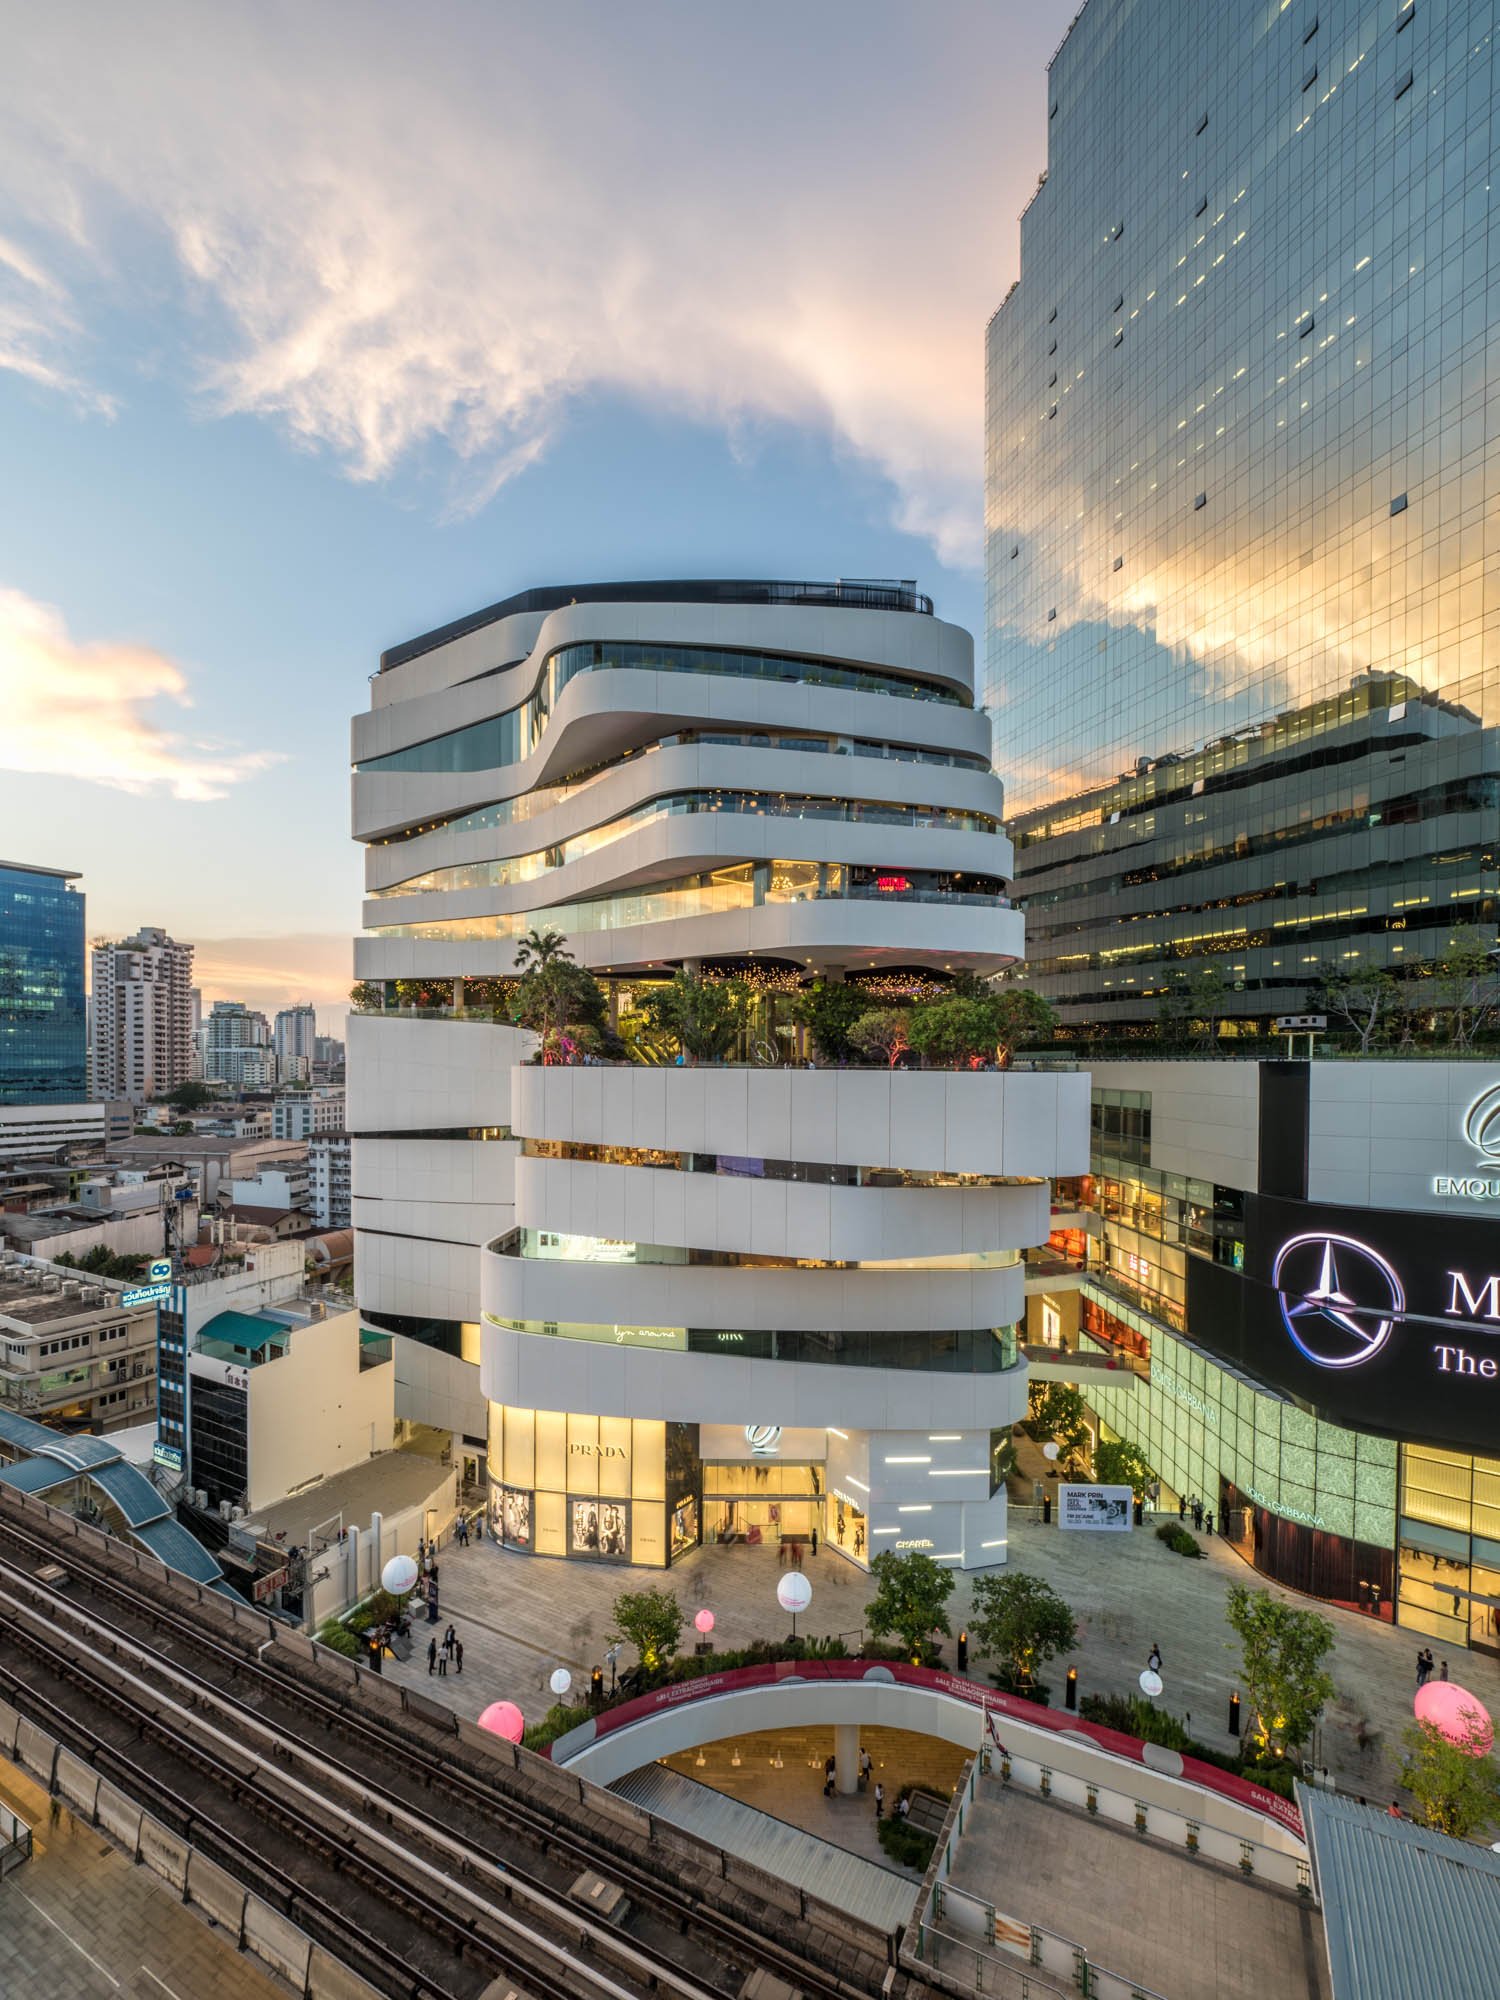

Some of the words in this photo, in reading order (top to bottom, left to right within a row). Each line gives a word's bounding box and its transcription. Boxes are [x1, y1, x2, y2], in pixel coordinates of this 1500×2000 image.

[613, 1323, 635, 1342] lyn
[638, 1328, 676, 1338] around
[1433, 1345, 1498, 1377] The
[1176, 1384, 1217, 1425] GABBANA
[569, 1443, 627, 1459] PRADA
[1246, 1484, 1267, 1504] DOLCE
[1271, 1501, 1326, 1527] GABBANA
[895, 1539, 935, 1549] CHANEL
[655, 1691, 670, 1703] SALE
[671, 1677, 724, 1697] EXTRAORDINAIRE
[935, 1676, 950, 1687] SALE
[951, 1682, 1008, 1706] EXTRAORDINAIRE
[1251, 1790, 1271, 1806] SALE
